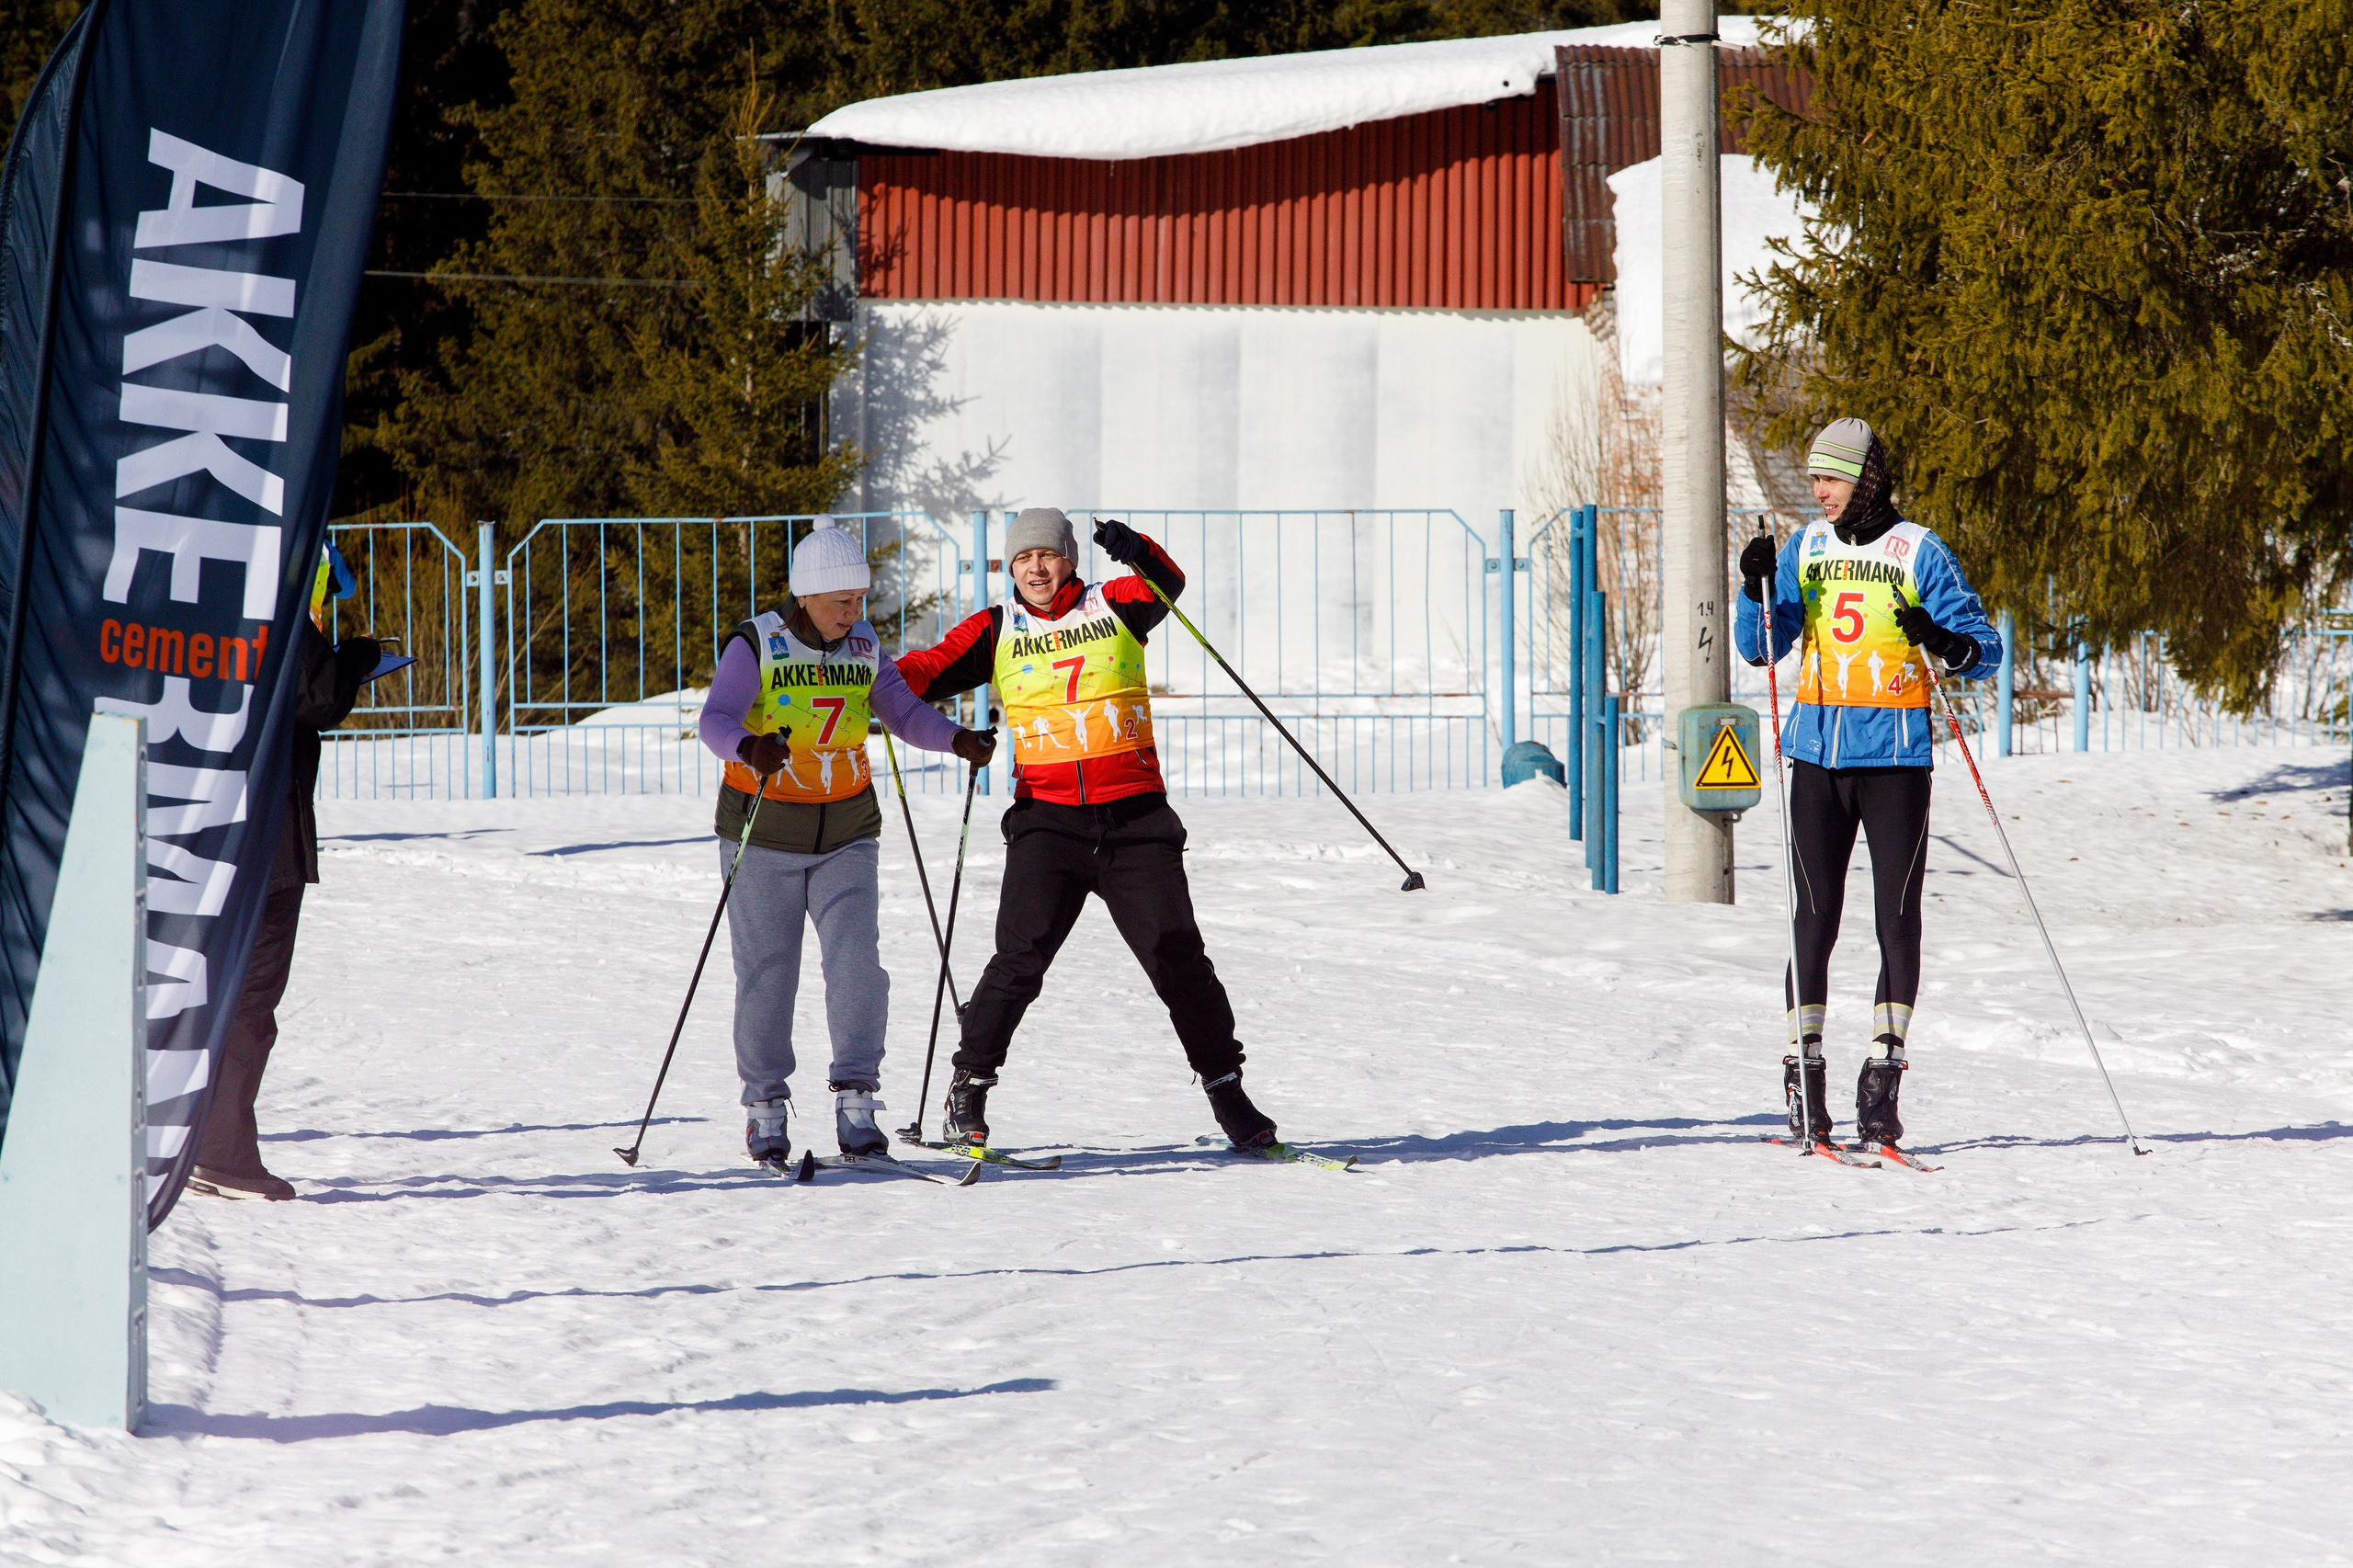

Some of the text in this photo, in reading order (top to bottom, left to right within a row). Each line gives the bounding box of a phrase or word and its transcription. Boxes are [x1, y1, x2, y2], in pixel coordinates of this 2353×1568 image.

[1803, 559, 1905, 587] AKKERMANN
[1831, 591, 1865, 643] 5
[100, 617, 269, 683] cement
[1012, 616, 1119, 659] AKKERMANN
[770, 664, 872, 690] AKKERMANN
[1051, 653, 1086, 704] 7
[1887, 674, 1903, 696] 4
[812, 697, 847, 746] 7
[1124, 718, 1138, 741] 2
[861, 760, 869, 780] 3
